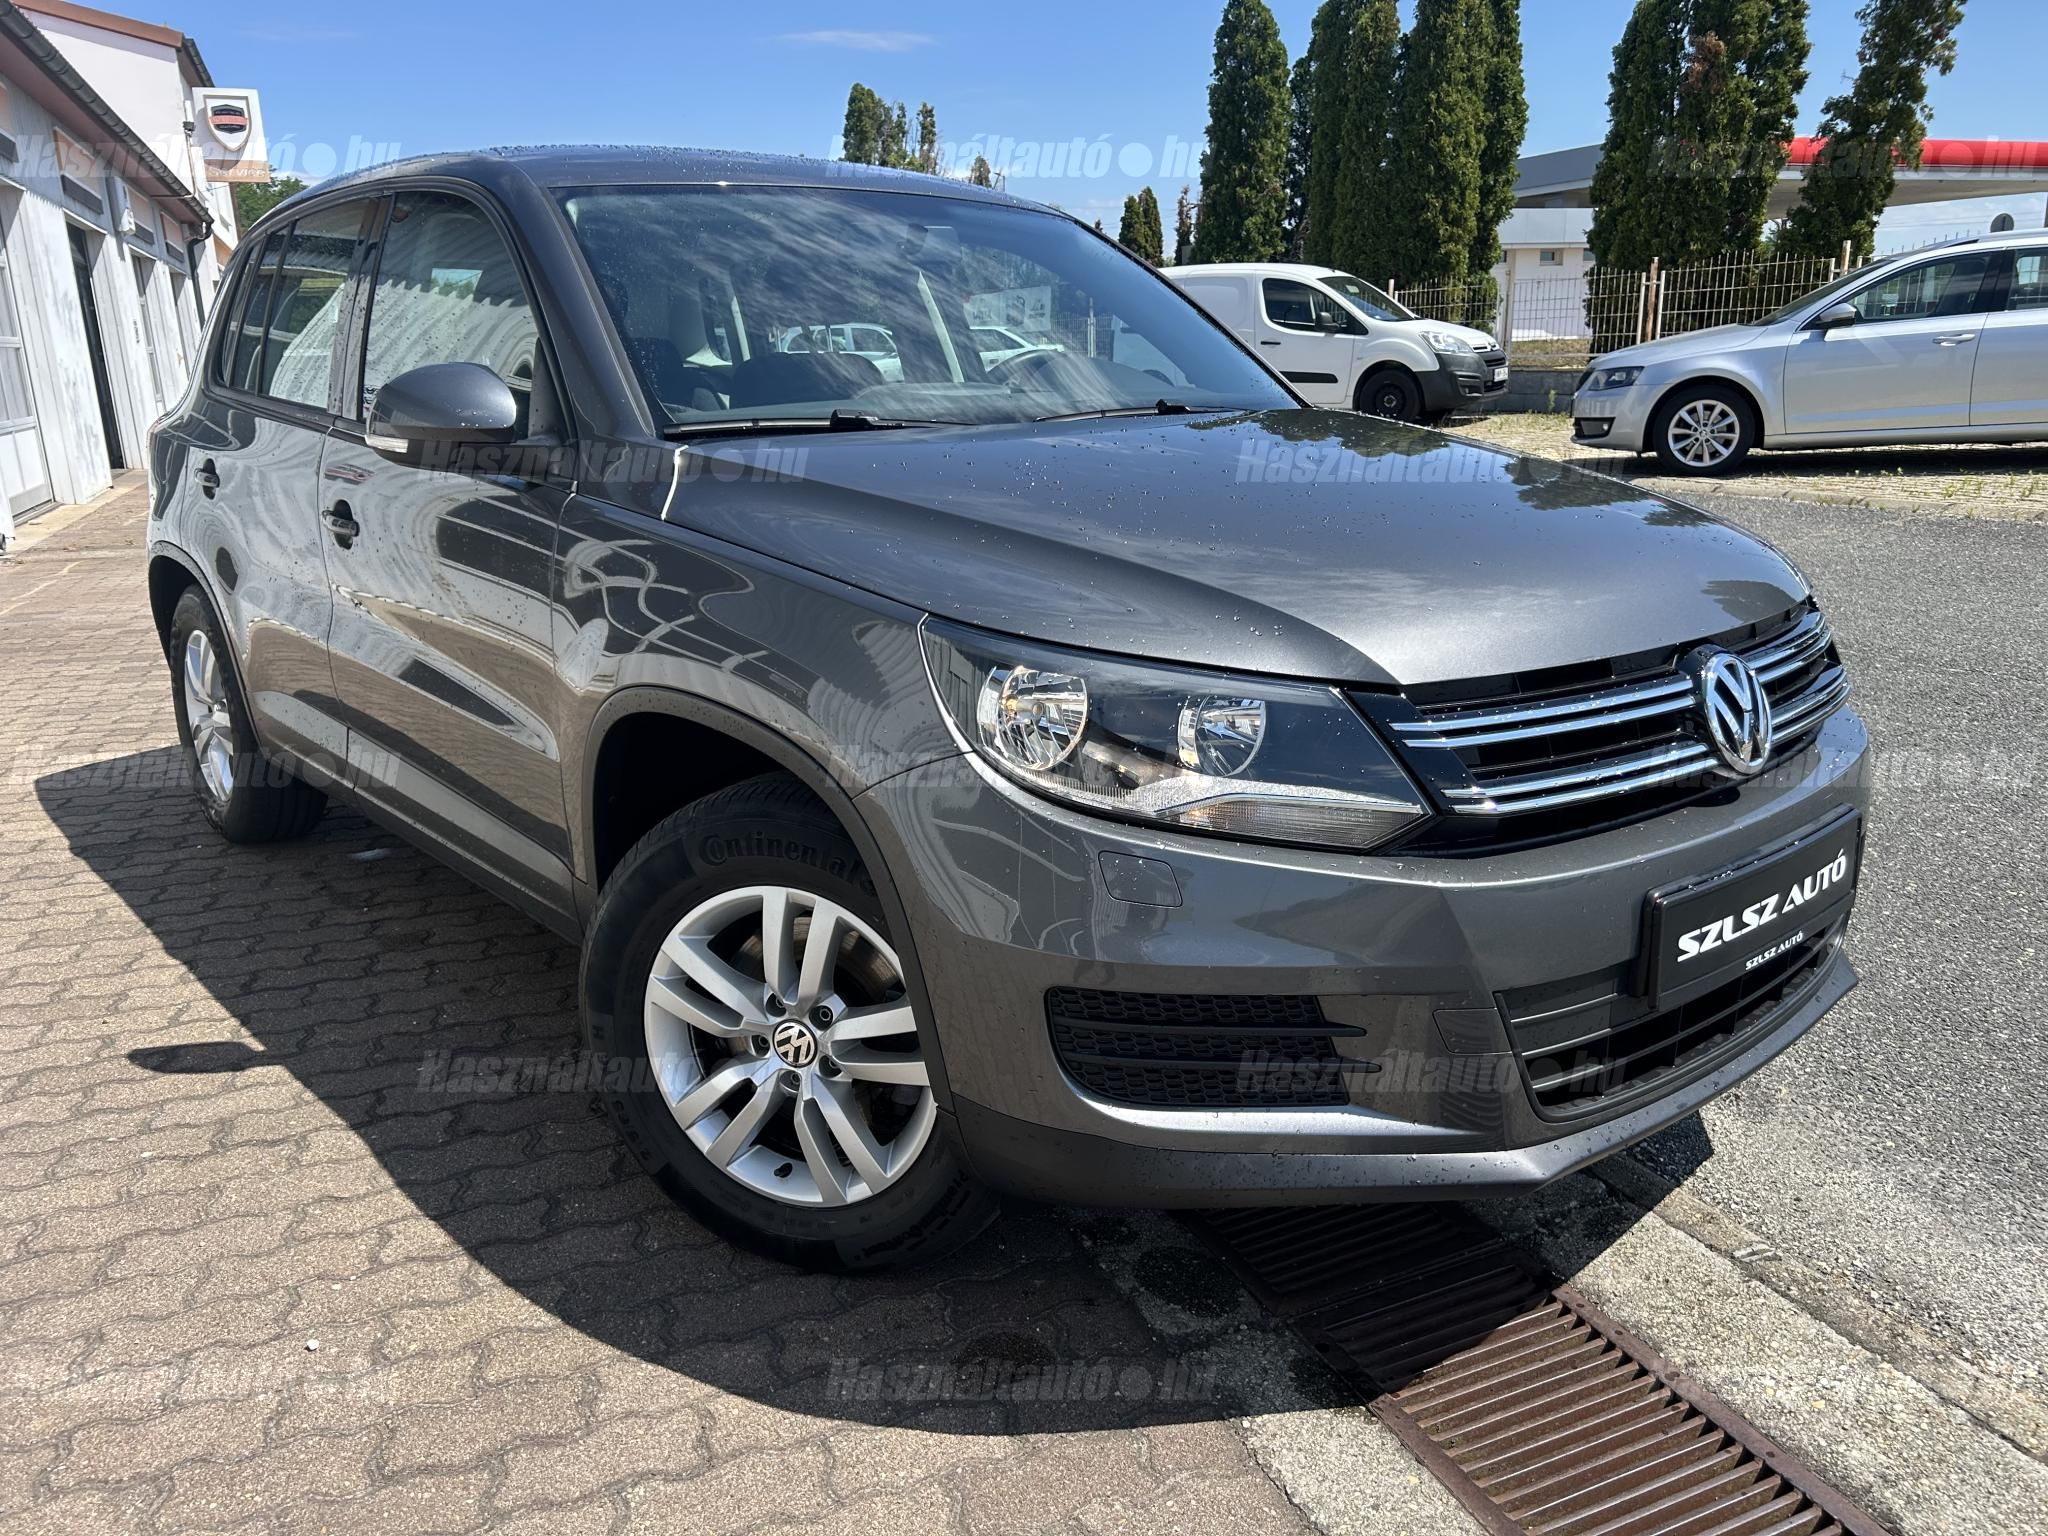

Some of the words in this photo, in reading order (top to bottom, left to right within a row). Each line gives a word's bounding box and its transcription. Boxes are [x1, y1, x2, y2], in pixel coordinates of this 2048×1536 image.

[1677, 893, 1779, 962] SZLSZ
[1781, 848, 1847, 914] AUTÓ
[1745, 946, 1777, 971] SZLSZ
[1778, 930, 1804, 954] AUTÓ
